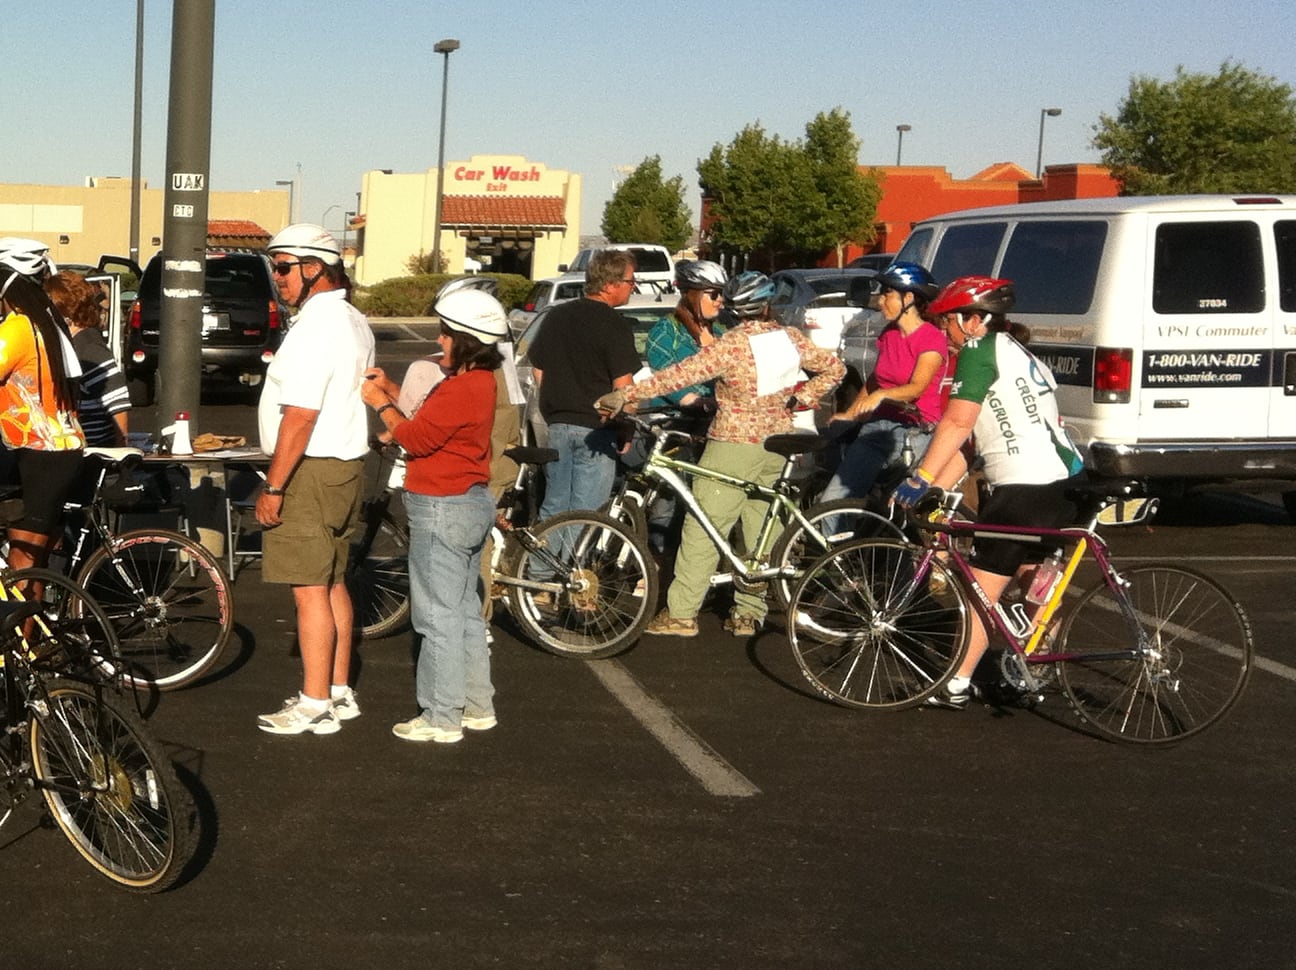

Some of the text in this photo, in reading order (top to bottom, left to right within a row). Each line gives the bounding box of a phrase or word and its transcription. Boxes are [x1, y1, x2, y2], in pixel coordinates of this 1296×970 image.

[454, 165, 540, 181] Car Wash
[486, 182, 508, 192] Exit
[1157, 325, 1189, 337] VPSI
[1196, 324, 1268, 337] Commuter
[1148, 353, 1262, 368] 1-800-VAN-RIDE
[1147, 371, 1242, 384] www.vanride.com
[987, 389, 1020, 456] AGRICOLE
